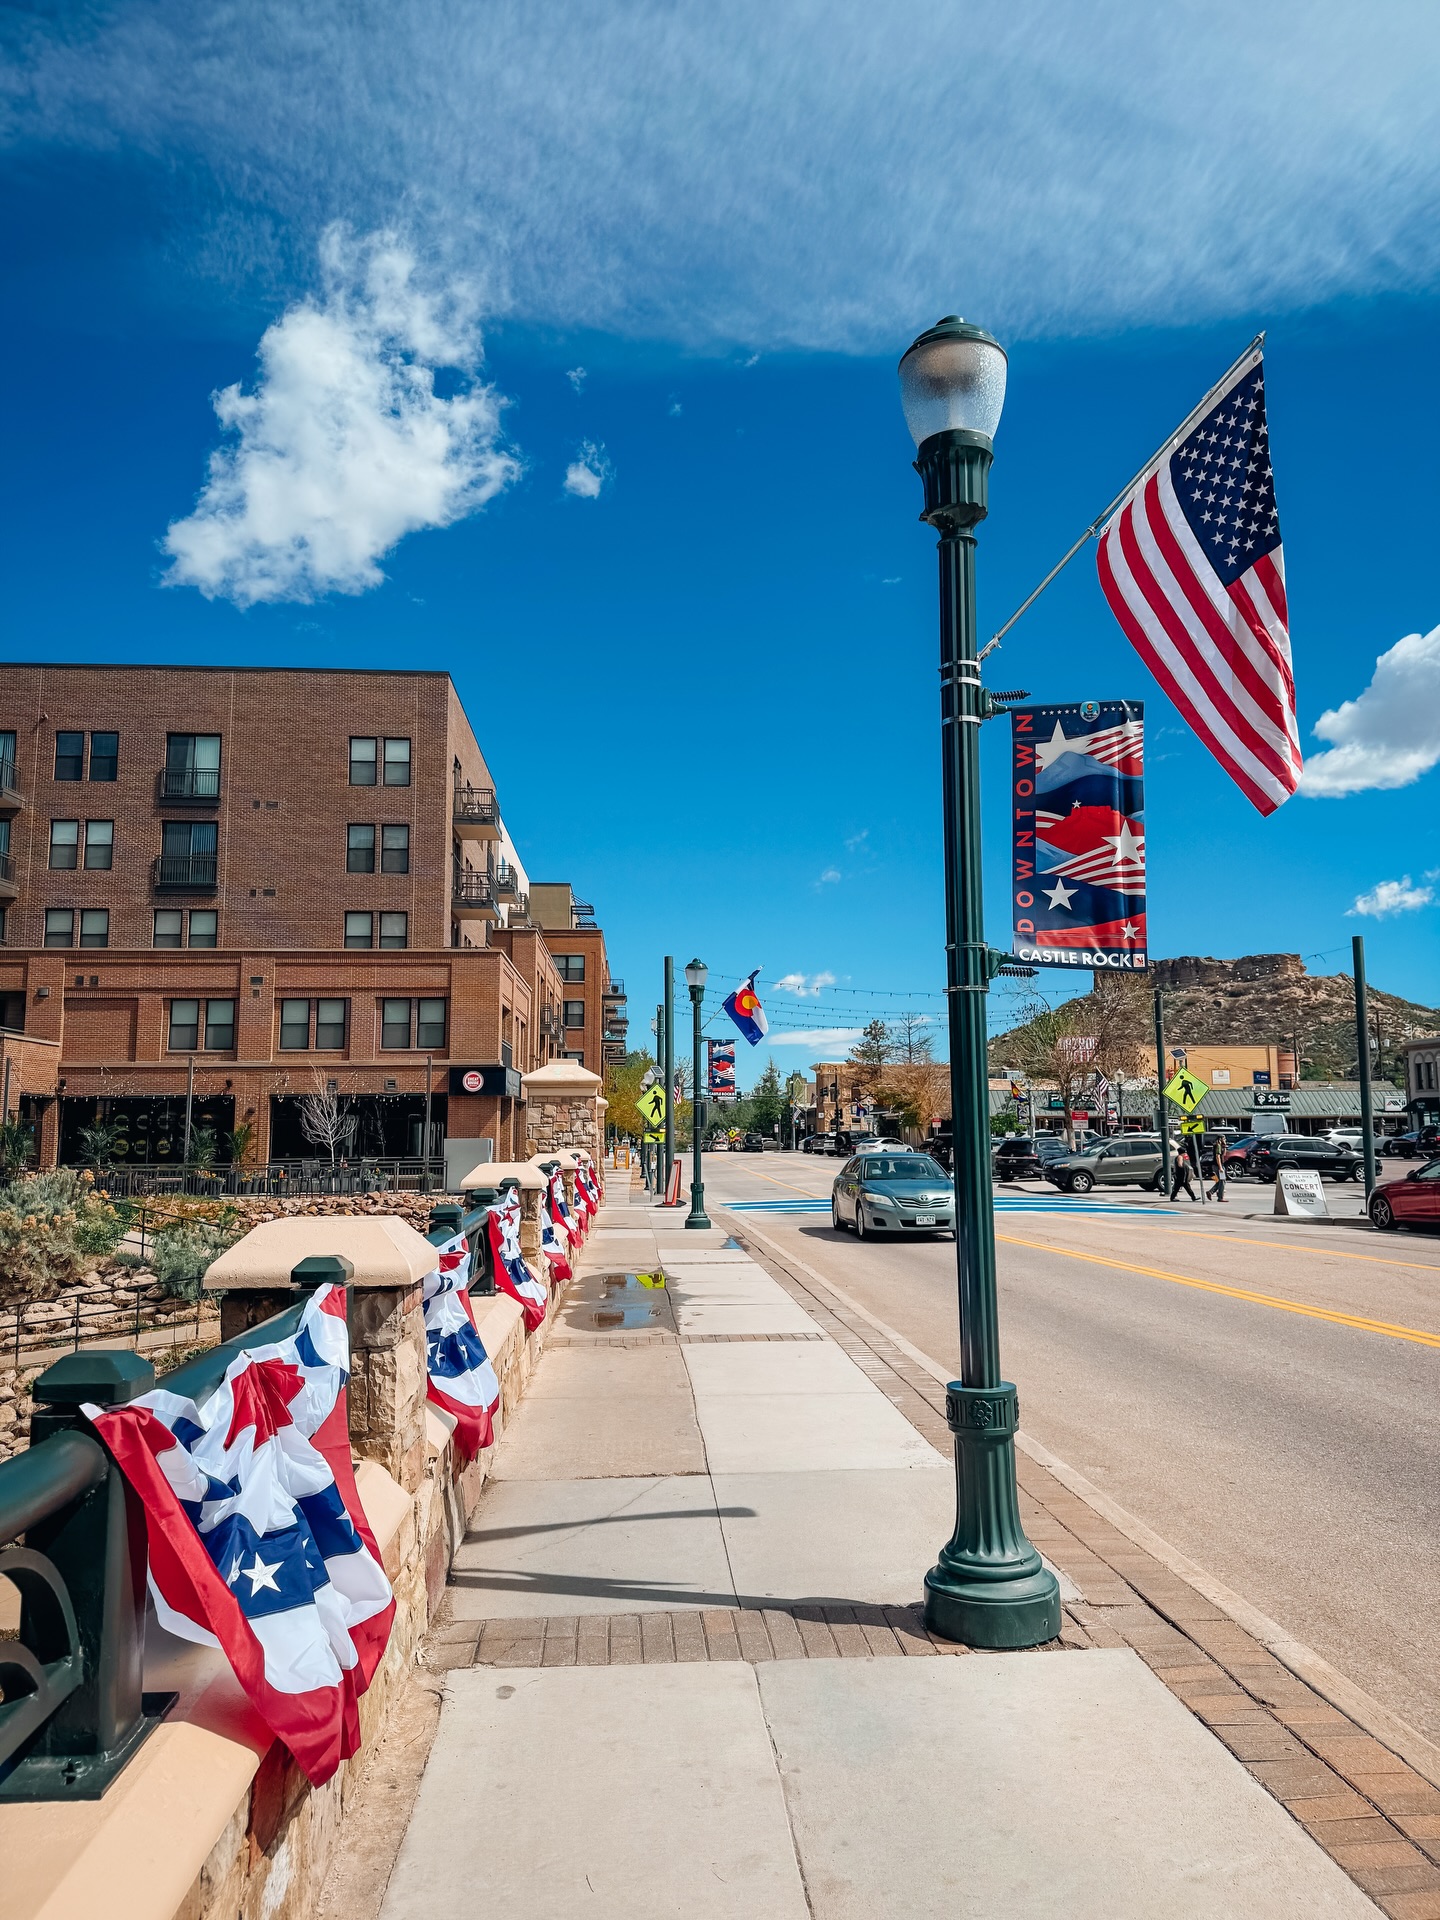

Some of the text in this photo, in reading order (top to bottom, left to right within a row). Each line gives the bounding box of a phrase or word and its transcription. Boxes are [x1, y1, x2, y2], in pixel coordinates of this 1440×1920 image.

[1016, 714, 1034, 933] DOWNTOWN
[1019, 949, 1132, 967] CASTLE ROCK
[1268, 1094, 1278, 1104] Sip
